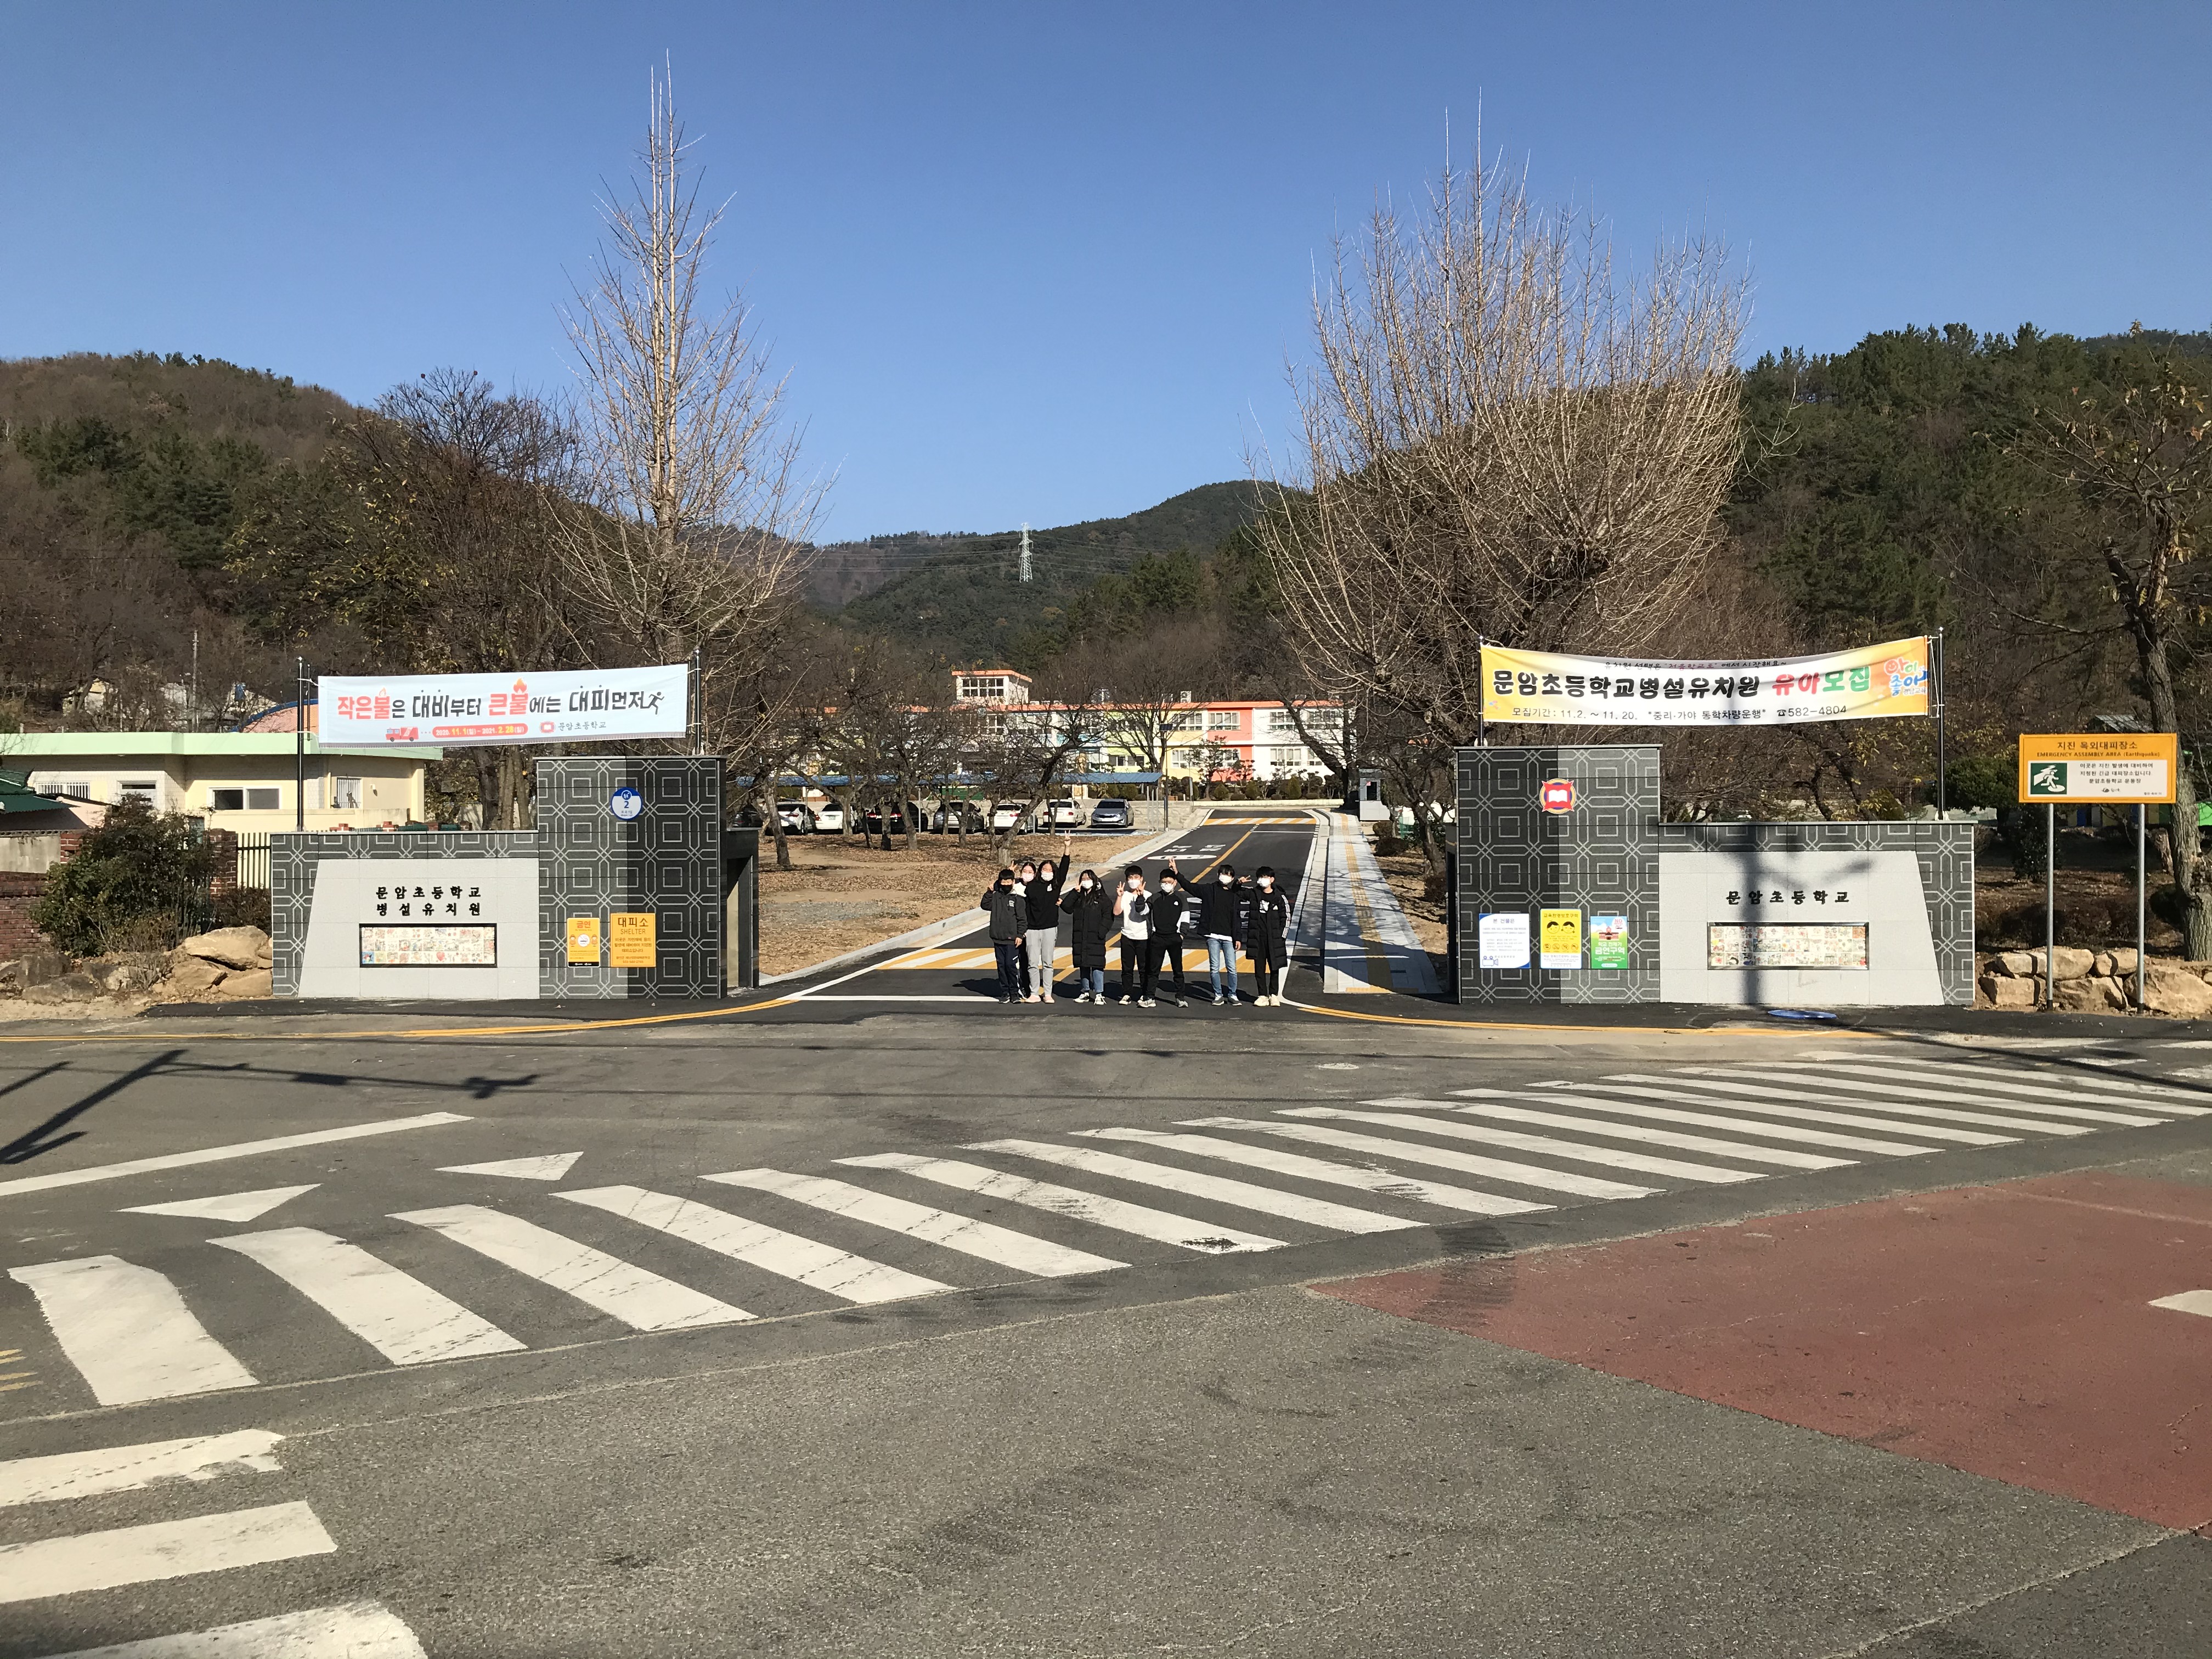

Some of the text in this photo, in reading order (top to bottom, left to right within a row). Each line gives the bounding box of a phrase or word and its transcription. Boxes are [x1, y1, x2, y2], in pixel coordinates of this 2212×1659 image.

[1493, 666, 1870, 699] 문암초등학교병설유치원 유아모집
[338, 689, 645, 720] 작은불은 대비부터 큰불에는 대피먼저
[1512, 707, 1556, 717] 모집기간:
[557, 721, 607, 731] 문암초등학교
[2057, 741, 2138, 751] 지진 옥외대피장소
[624, 800, 629, 809] 2
[376, 885, 481, 900] 문암초등학교
[1726, 890, 1849, 905] 문암초등학교
[376, 902, 481, 917] 병설유치원
[618, 917, 648, 928] 대피소
